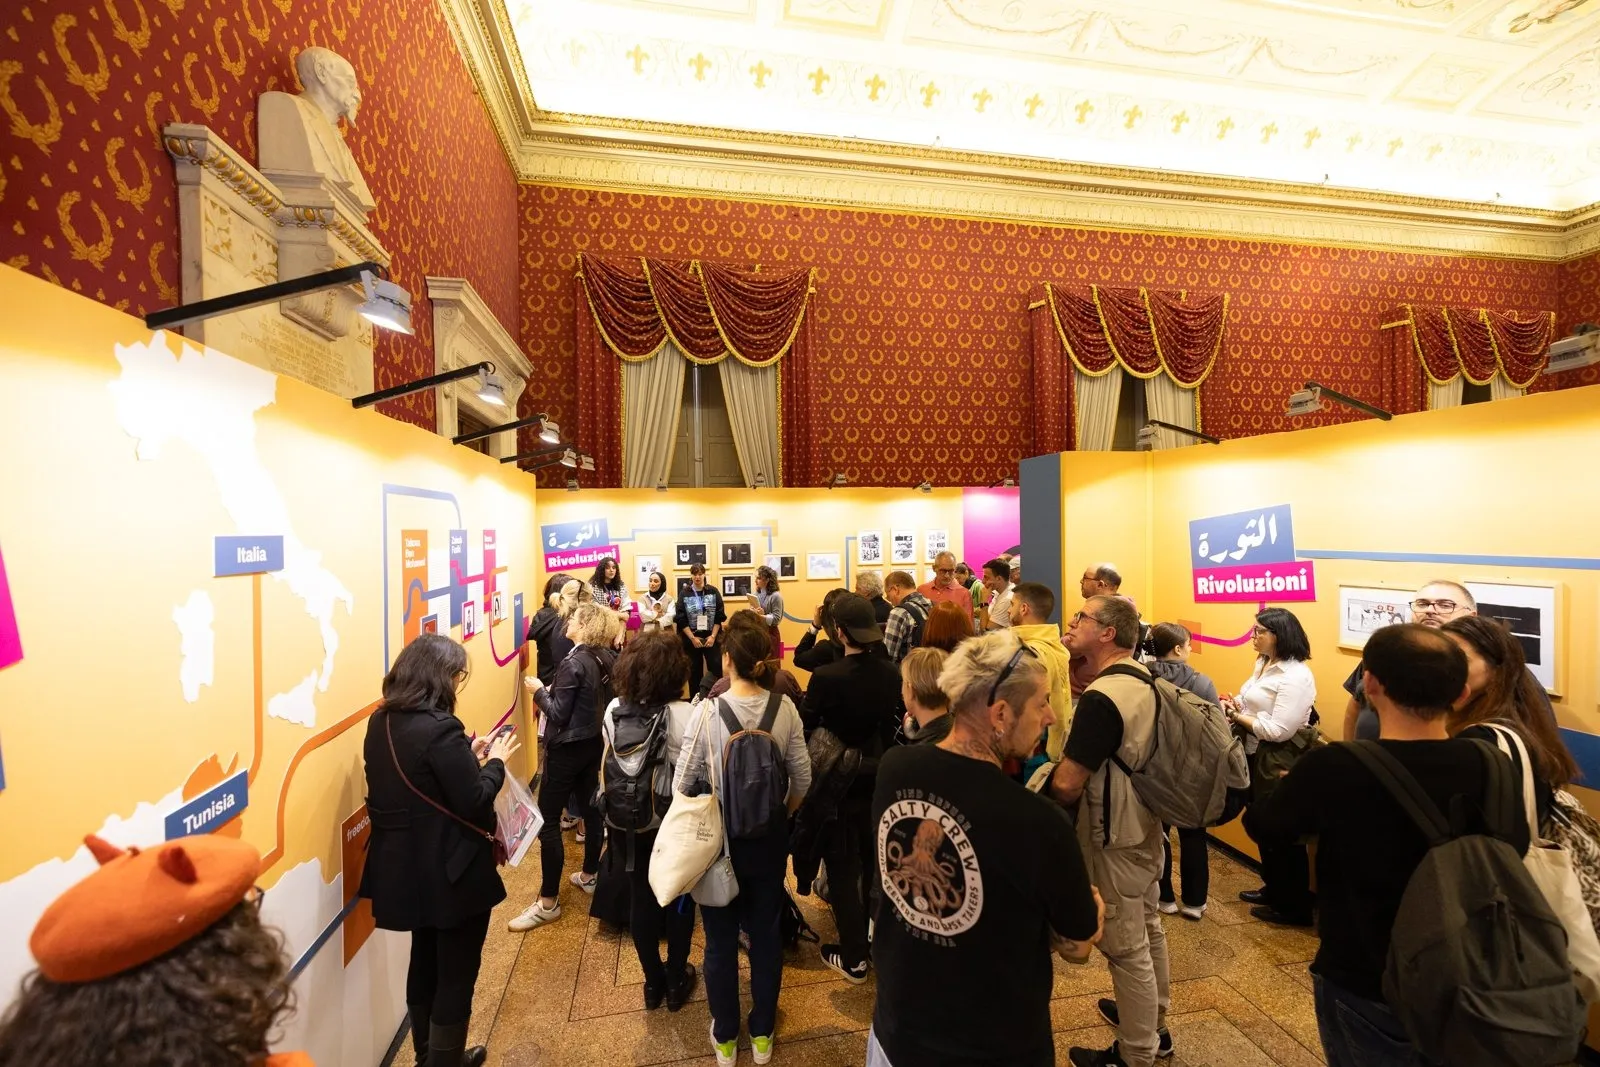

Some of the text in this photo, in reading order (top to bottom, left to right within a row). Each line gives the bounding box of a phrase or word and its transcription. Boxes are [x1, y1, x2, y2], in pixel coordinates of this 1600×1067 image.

[237, 545, 267, 563] Italia
[1197, 568, 1307, 595] Rivoluzioni
[183, 793, 235, 834] Tunisia
[347, 815, 370, 842] freedo
[882, 801, 978, 873] SALTY CREW
[883, 878, 916, 921] SEEKERS
[919, 917, 941, 930] AND
[962, 886, 979, 922] TAKERS
